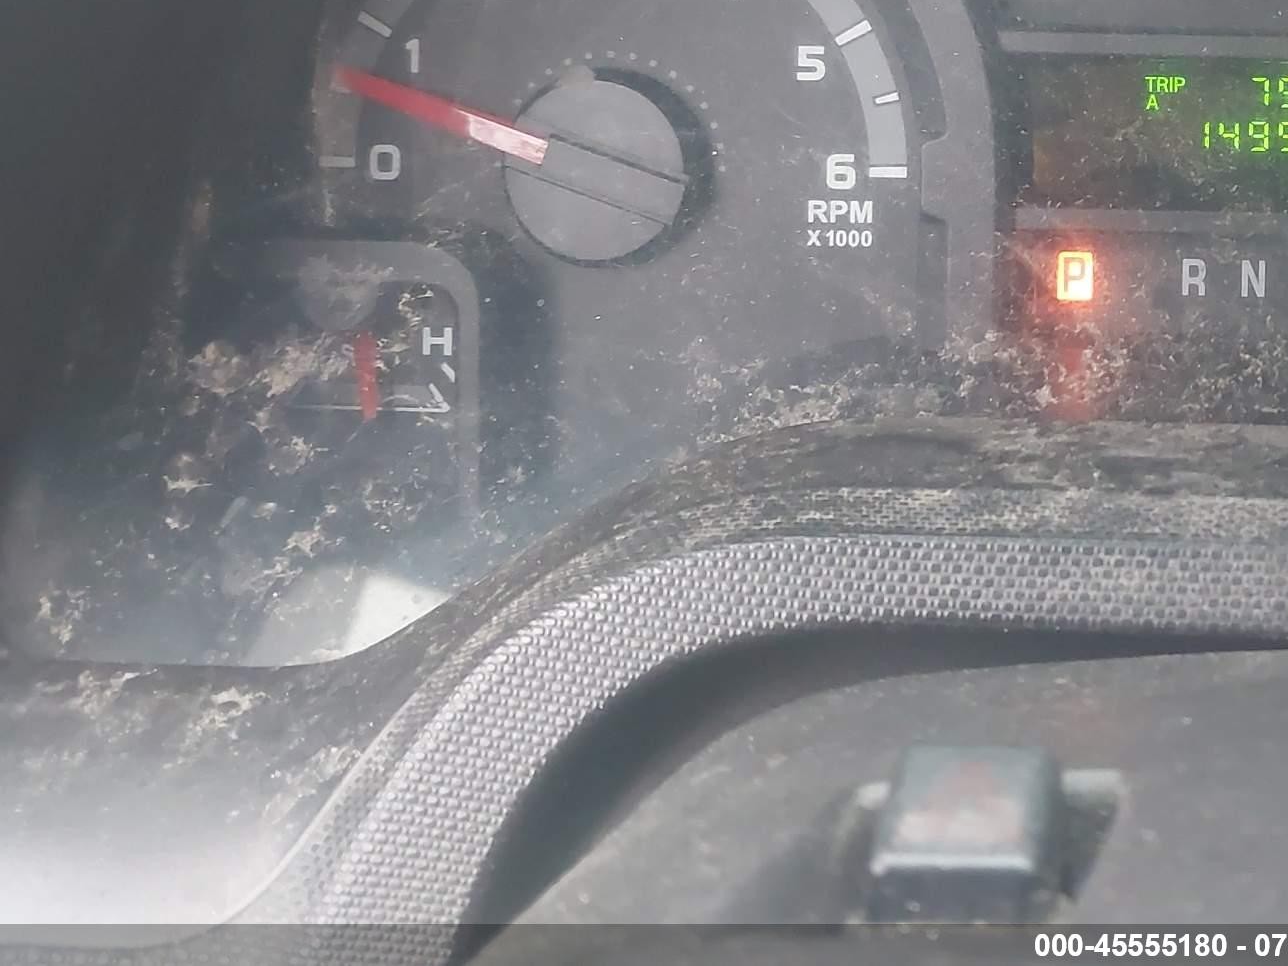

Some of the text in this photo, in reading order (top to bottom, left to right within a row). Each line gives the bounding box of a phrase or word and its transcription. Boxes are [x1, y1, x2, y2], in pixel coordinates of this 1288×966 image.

[405, 38, 420, 74] 1
[796, 45, 827, 81] 5
[1144, 76, 1187, 94] TRIP
[1145, 94, 1164, 111] A
[369, 144, 402, 181] 0
[826, 153, 857, 190] 6
[807, 199, 874, 224] RPM
[806, 229, 873, 248] X 1000
[1062, 255, 1088, 295] P
[1181, 258, 1207, 297] R
[1241, 259, 1267, 298] N
[422, 326, 454, 356] H
